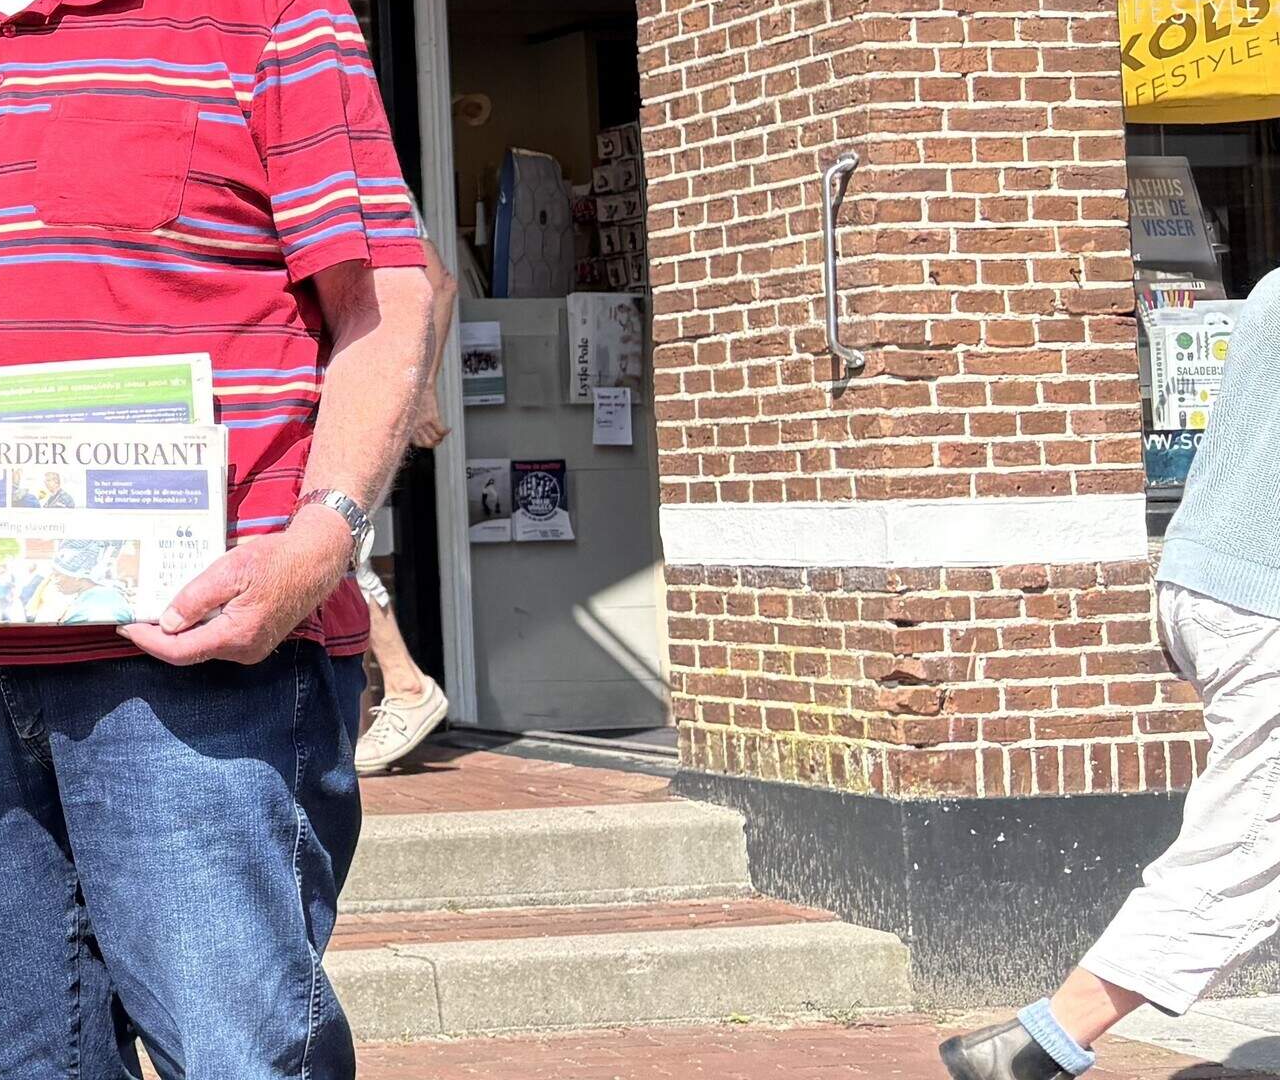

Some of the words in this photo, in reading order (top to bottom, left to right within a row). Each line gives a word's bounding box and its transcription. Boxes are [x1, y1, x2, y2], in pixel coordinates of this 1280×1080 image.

[1124, 34, 1263, 108] IFESTYLE
[1168, 199, 1190, 216] DE
[1141, 219, 1196, 237] VISSER
[75, 442, 208, 466] COURANT
